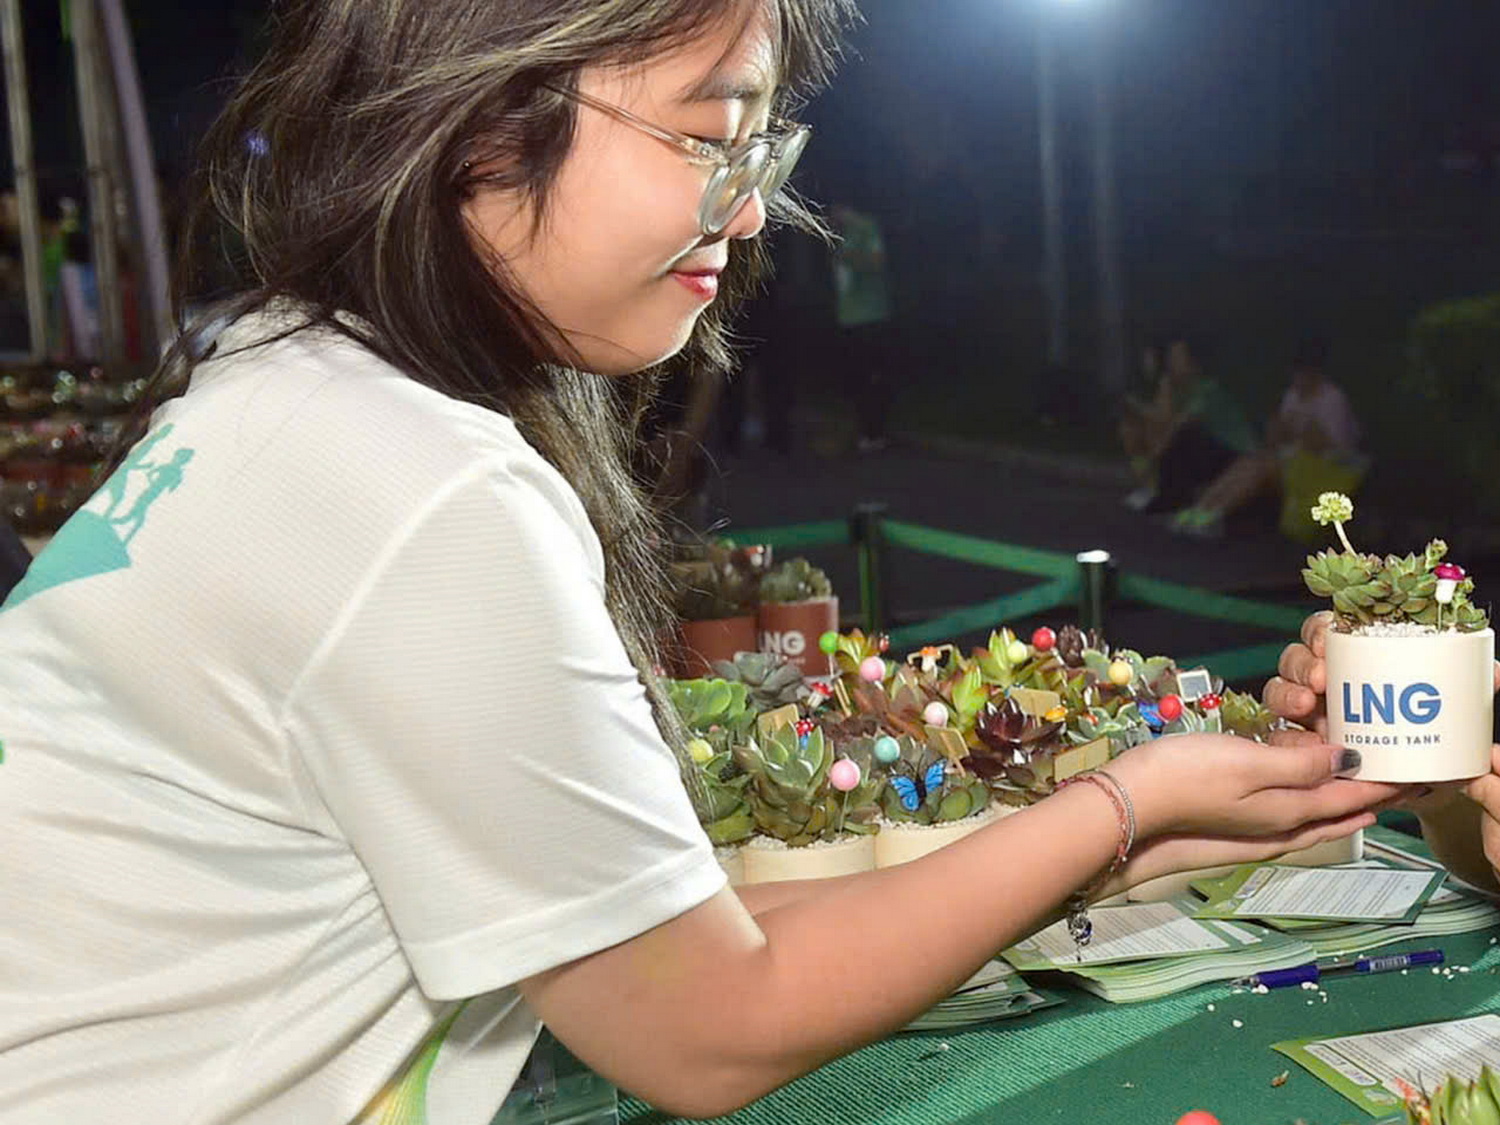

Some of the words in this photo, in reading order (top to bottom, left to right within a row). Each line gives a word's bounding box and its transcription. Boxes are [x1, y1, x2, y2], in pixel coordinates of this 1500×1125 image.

[1343, 681, 1441, 725] LNG
[1344, 733, 1399, 745] STORAGE
[1406, 734, 1441, 745] TANK
